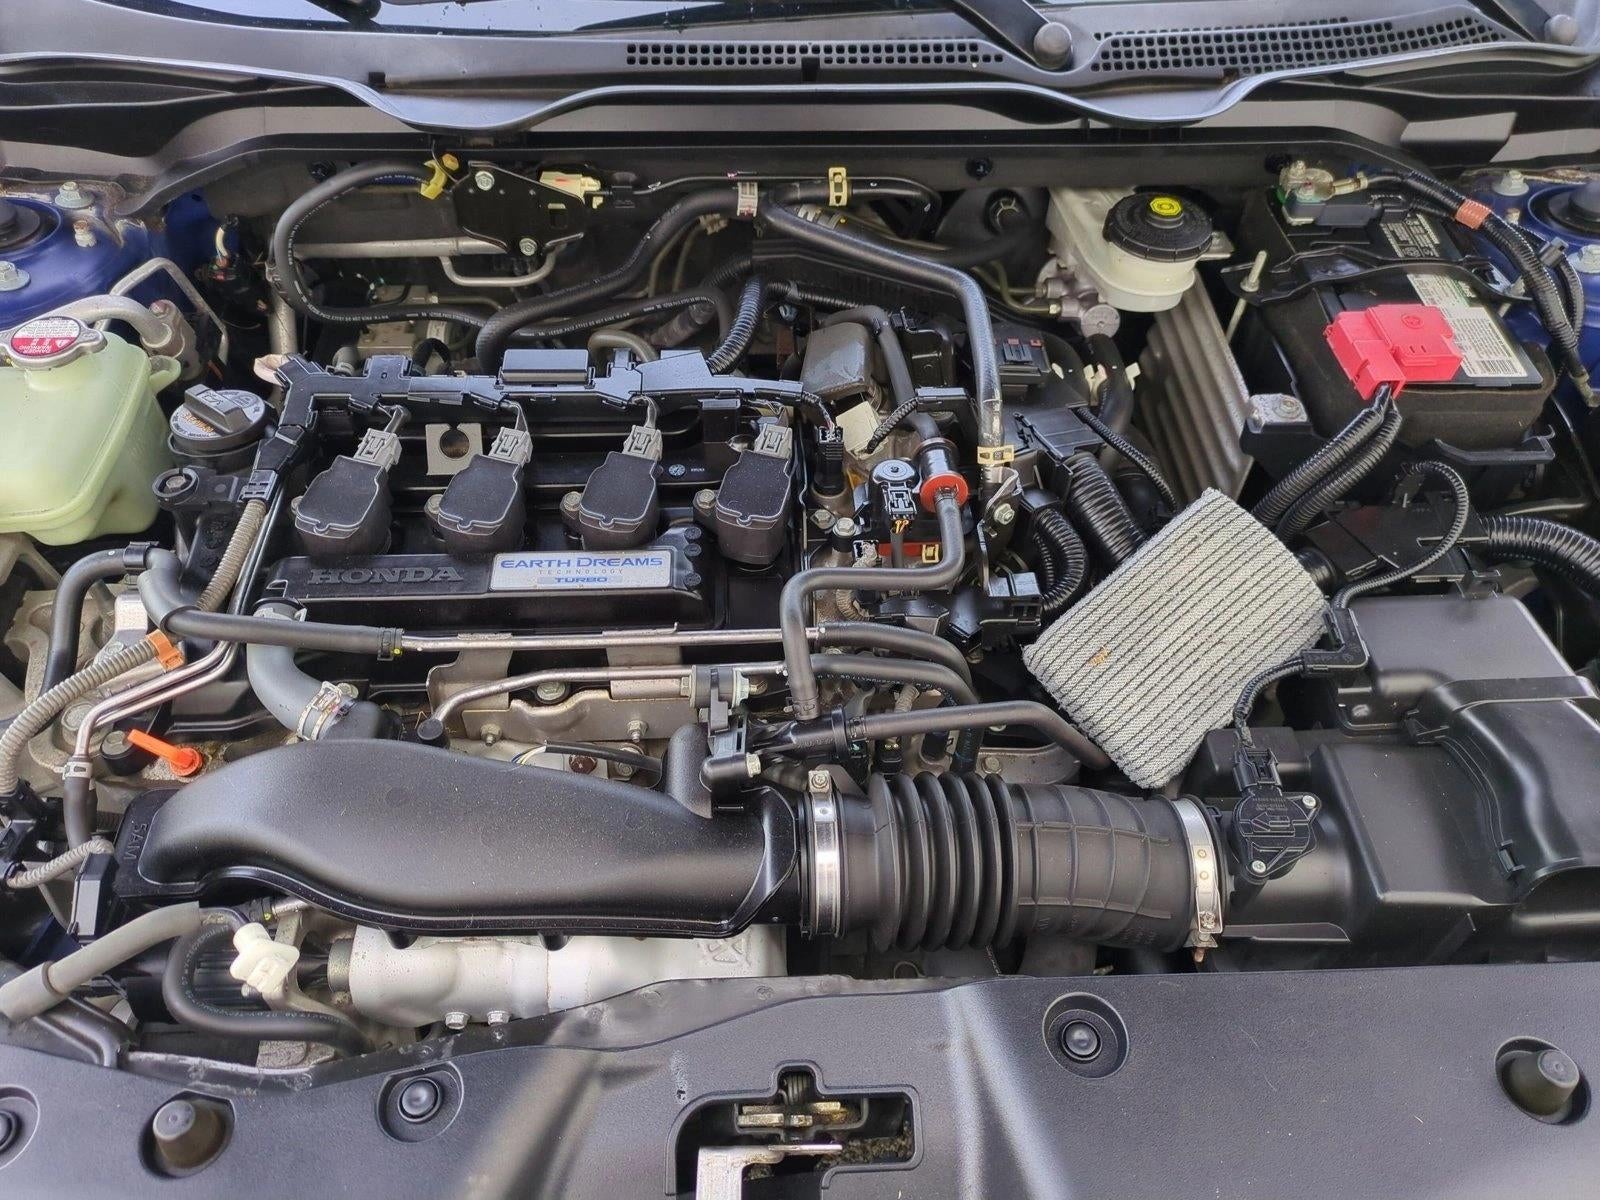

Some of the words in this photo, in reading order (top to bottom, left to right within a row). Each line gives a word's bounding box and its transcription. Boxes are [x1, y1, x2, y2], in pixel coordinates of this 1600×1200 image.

[500, 559, 571, 569] EARTH
[576, 557, 663, 567] DREAMS
[307, 566, 464, 585] HONDA
